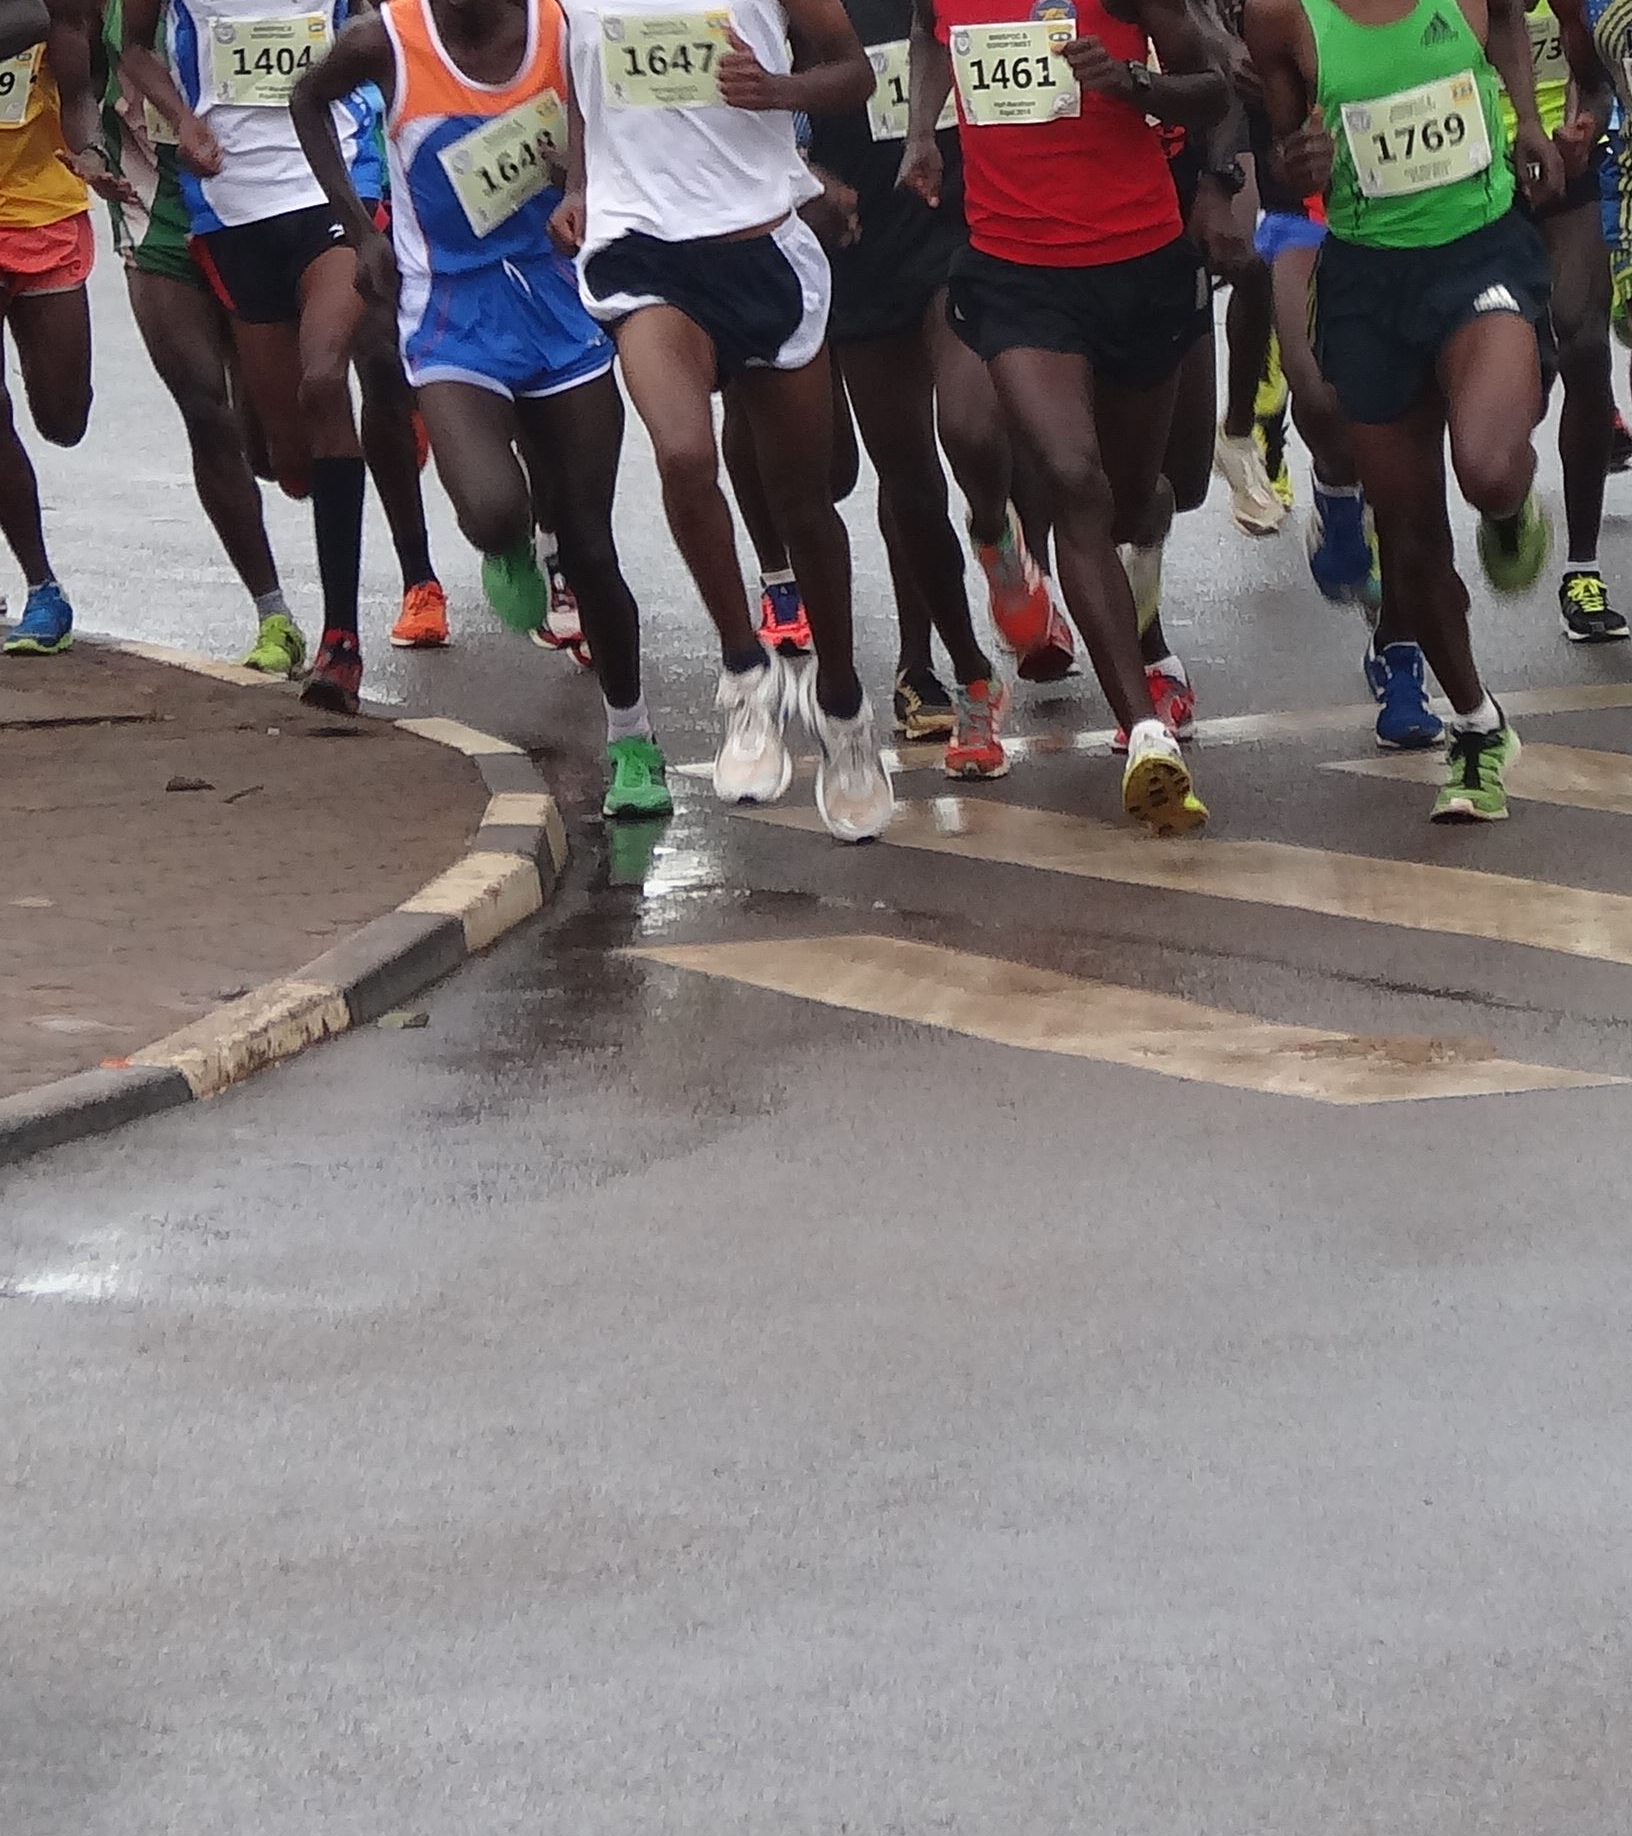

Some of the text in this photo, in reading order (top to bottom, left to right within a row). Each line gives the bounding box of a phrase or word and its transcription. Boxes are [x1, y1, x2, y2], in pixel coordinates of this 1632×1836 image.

[233, 45, 314, 76] 1404
[622, 41, 716, 76] 1647
[970, 56, 1057, 91] 1461
[1372, 111, 1466, 165] 1769
